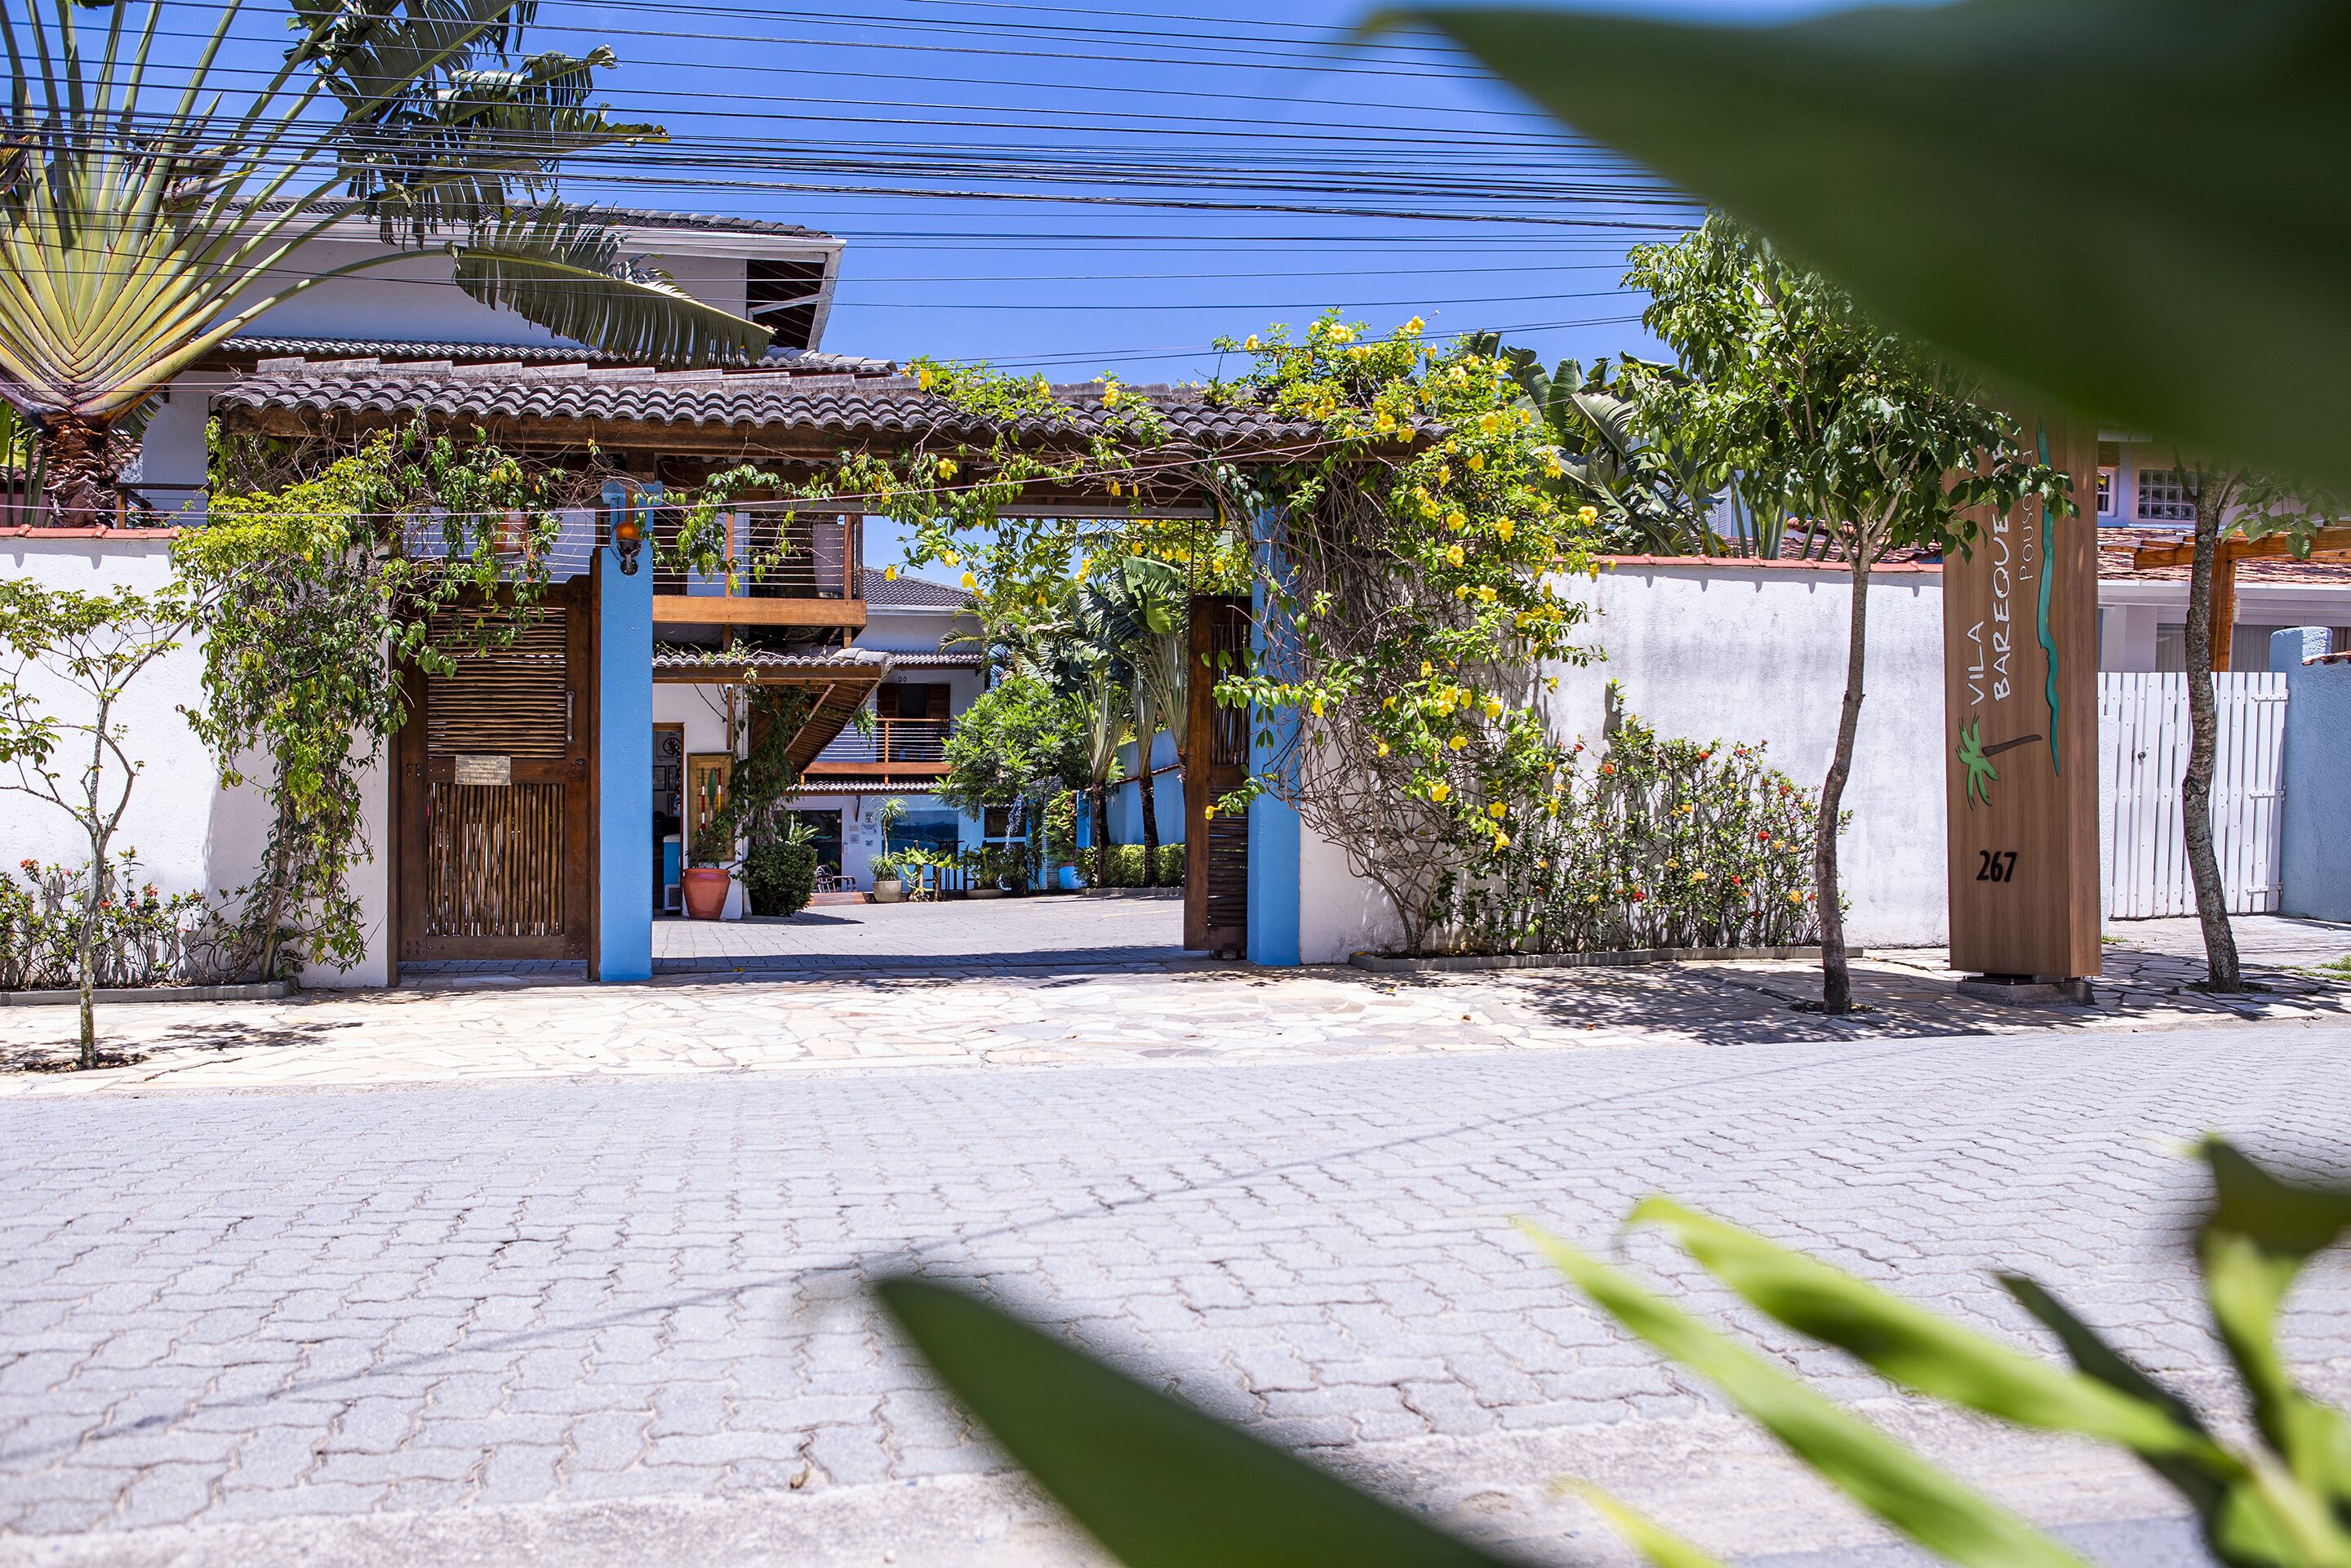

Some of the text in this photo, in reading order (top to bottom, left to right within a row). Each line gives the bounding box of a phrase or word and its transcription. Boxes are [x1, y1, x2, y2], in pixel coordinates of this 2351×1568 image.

[2019, 450, 2033, 580] Pousaa
[1966, 620, 1984, 706] VILA
[1976, 851, 2017, 882] 267
